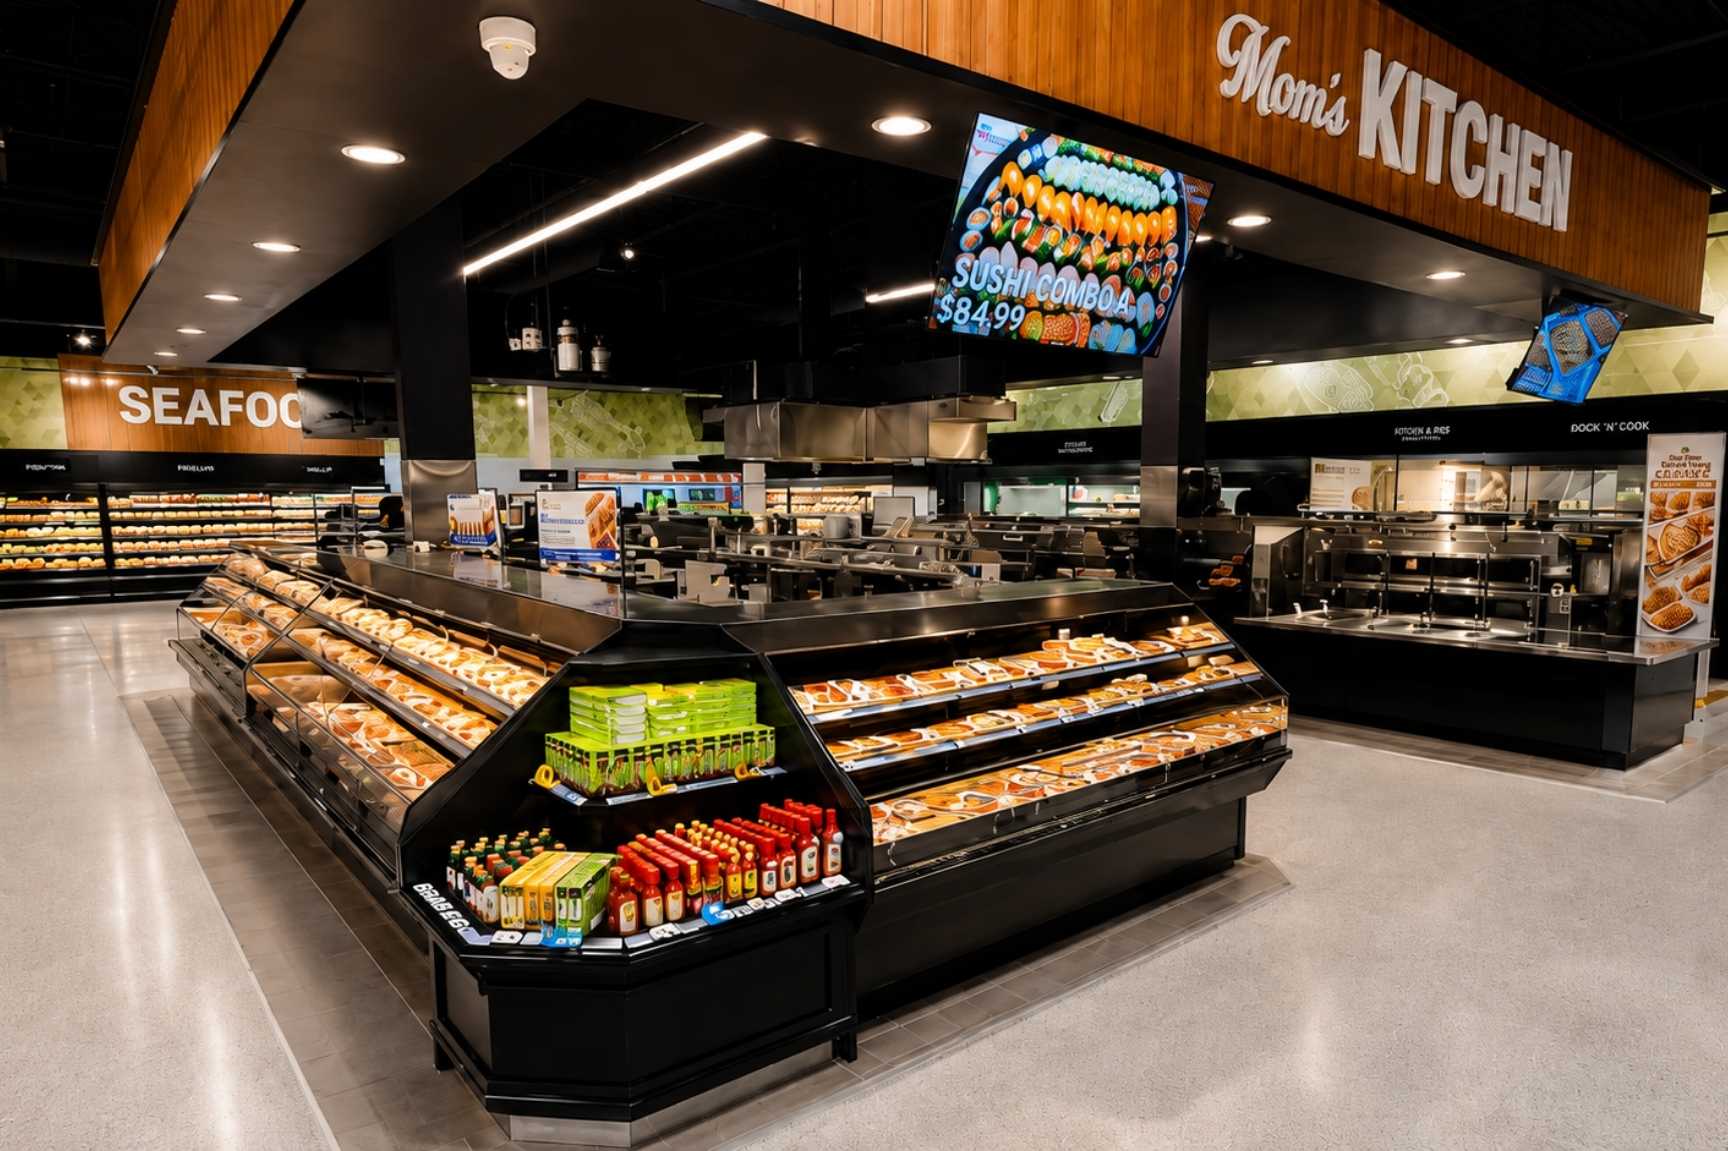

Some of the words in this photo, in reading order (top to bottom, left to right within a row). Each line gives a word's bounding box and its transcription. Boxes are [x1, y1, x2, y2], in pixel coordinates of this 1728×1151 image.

[1216, 13, 1350, 136] Mom's
[1358, 48, 1573, 232] KITCHEN
[951, 257, 1031, 299] SUSHI
[1035, 273, 1115, 312] COMBO
[1114, 288, 1130, 314] A
[936, 292, 1026, 332] $84.99
[1571, 422, 1601, 433] DOCK
[1619, 420, 1650, 432] COOK
